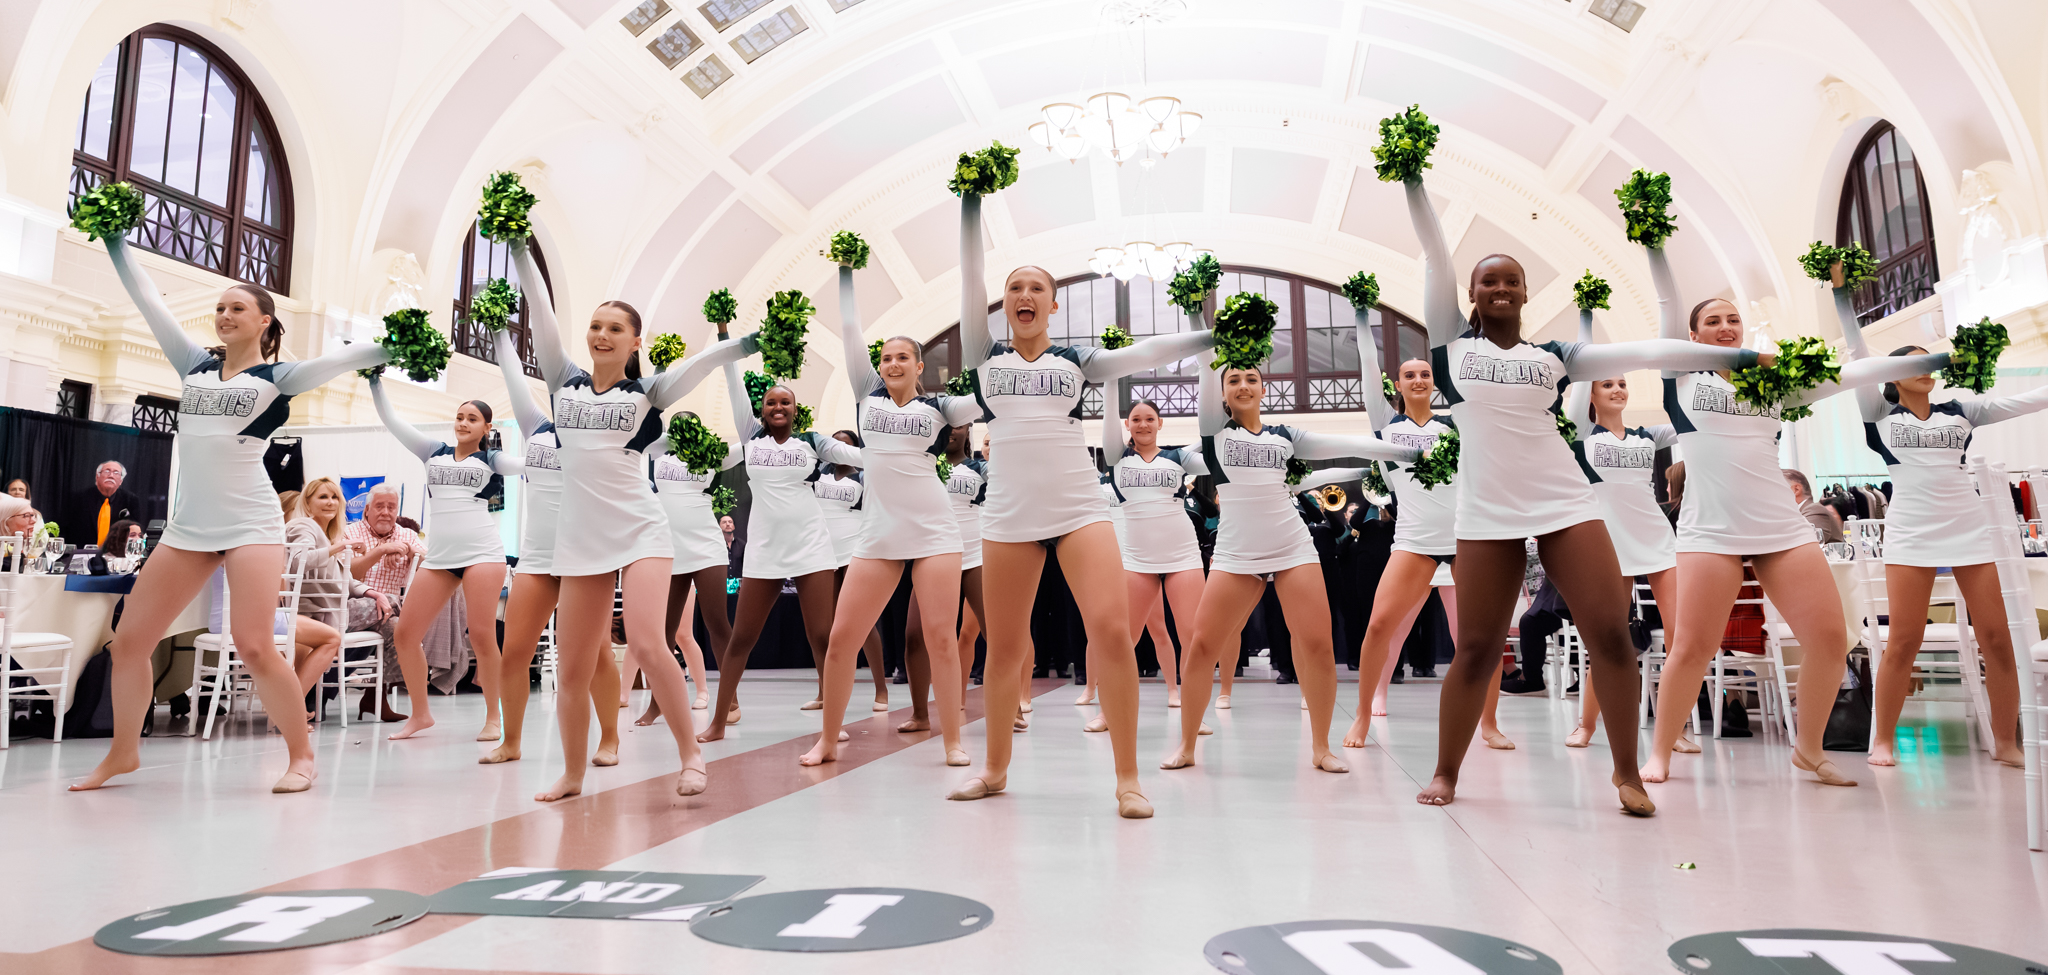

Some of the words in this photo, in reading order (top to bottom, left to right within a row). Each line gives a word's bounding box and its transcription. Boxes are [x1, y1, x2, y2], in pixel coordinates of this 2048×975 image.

[986, 367, 1076, 399] PATRIOTS
[1460, 351, 1554, 390] PATRIOTS
[863, 405, 932, 438] PATRIOTS
[1120, 466, 1178, 488] PATRIOTS
[490, 880, 684, 904] AND
[131, 895, 375, 943] R
[776, 893, 905, 939] I
[1735, 937, 1957, 975] T
